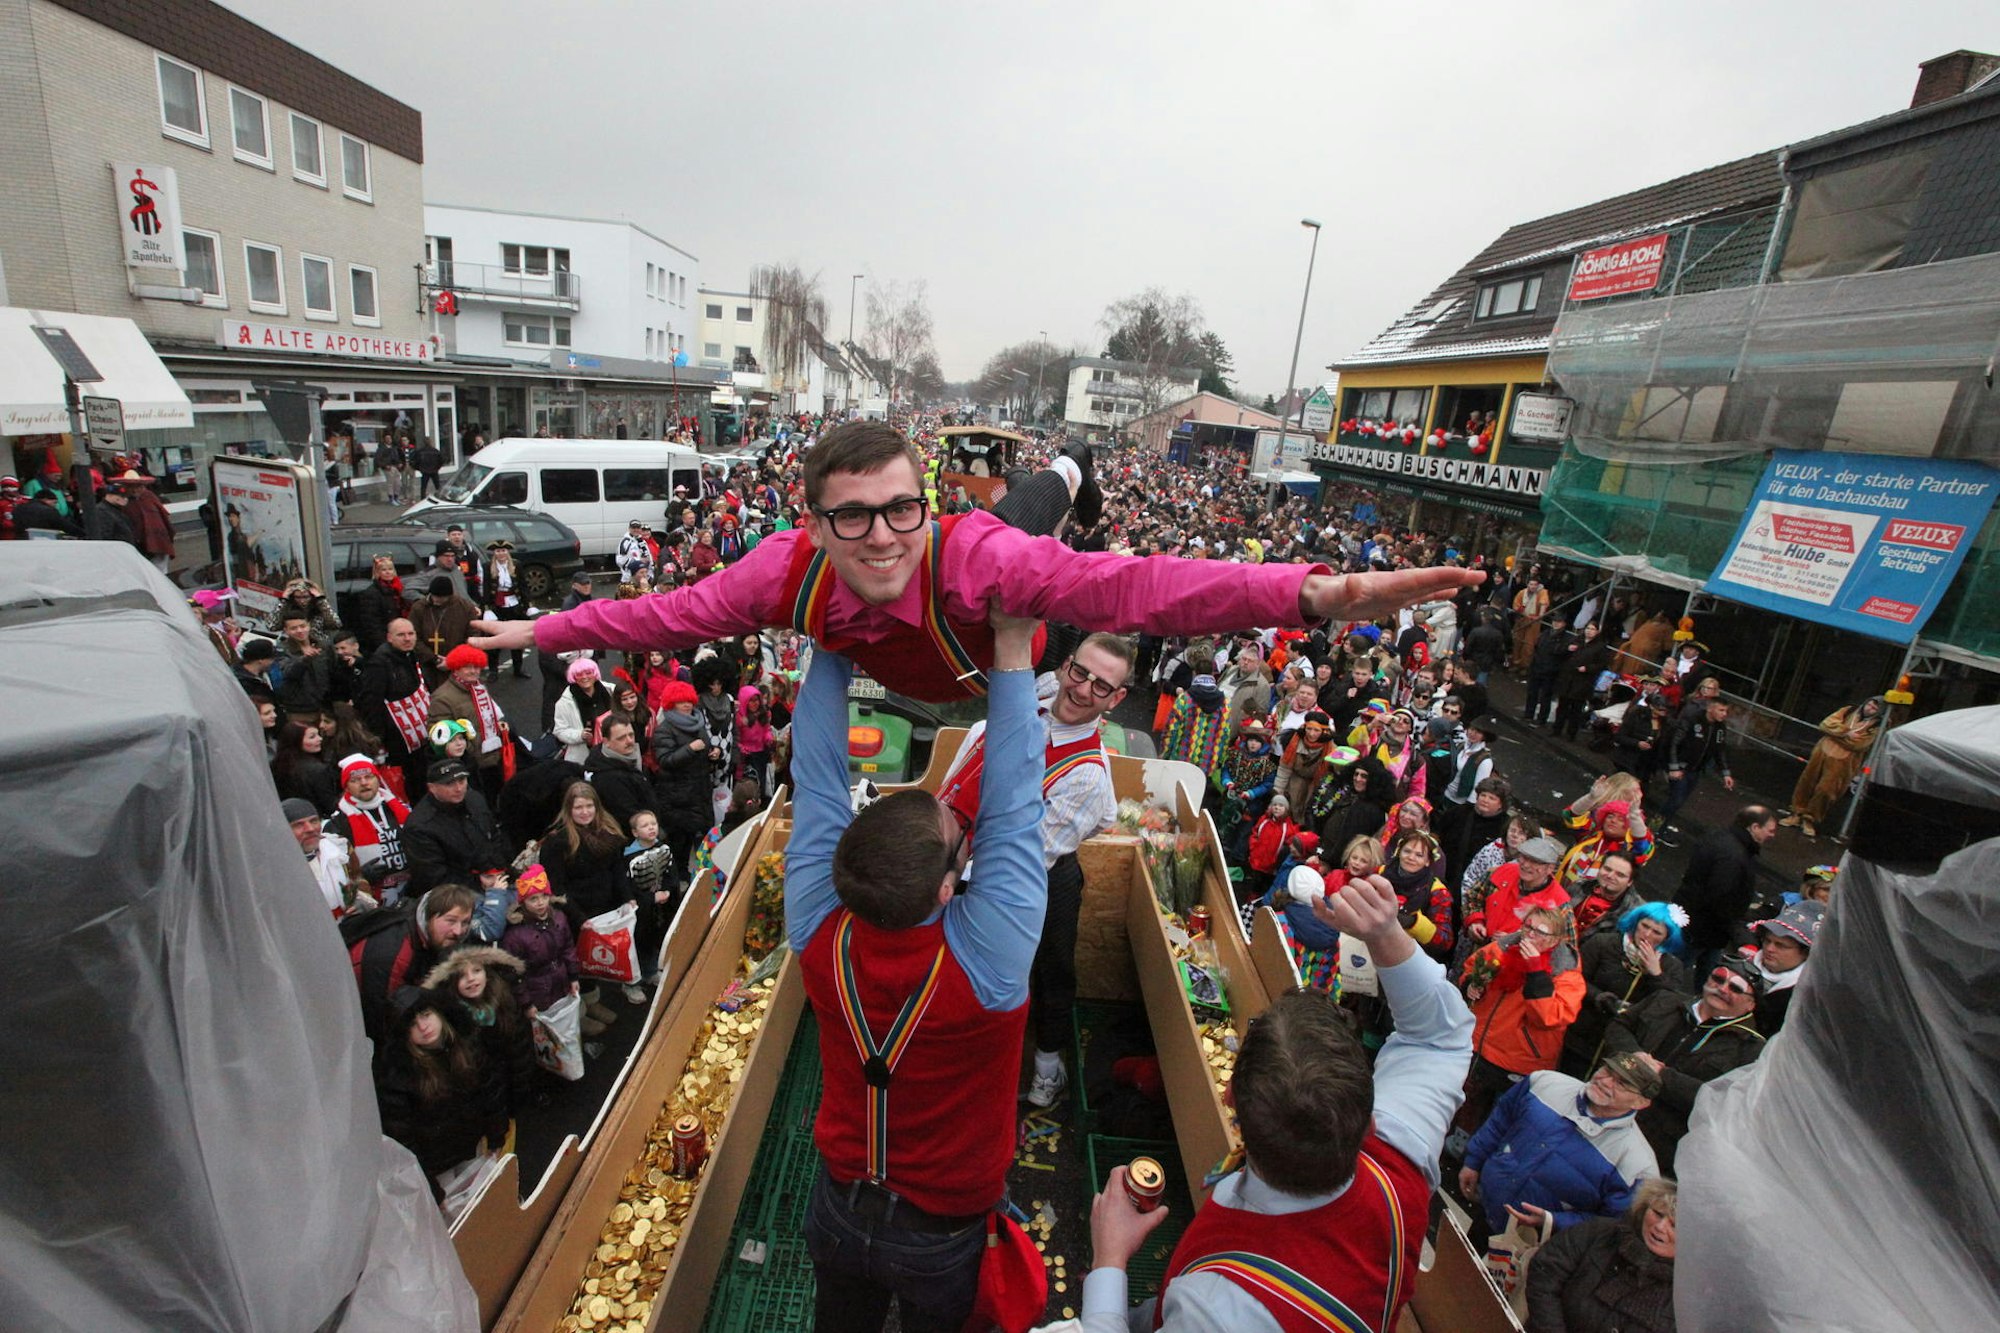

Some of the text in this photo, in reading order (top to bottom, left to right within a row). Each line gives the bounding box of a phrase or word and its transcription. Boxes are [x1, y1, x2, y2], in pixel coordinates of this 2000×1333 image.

[142, 240, 160, 251] Alte
[132, 250, 173, 264] Apotheke
[1576, 254, 1620, 275] RÖHRIG
[1619, 251, 1629, 267] &
[1630, 244, 1662, 265] POHL
[263, 328, 314, 349] ALTE
[325, 335, 412, 357] APOTHEKE
[1313, 444, 1541, 493] SCHUHHAUS BUSCHMANN
[1775, 463, 1823, 481] VELUX
[1835, 469, 1861, 485] der
[1863, 474, 1914, 491] starke
[1918, 476, 1989, 496] Partner
[1767, 480, 1909, 510] für den Dachausbau
[1783, 518, 1843, 533] Fachbetrieb für
[1792, 535, 1850, 551] Abdichtungen
[1808, 529, 1850, 543] Fassaden
[1784, 543, 1826, 563] Hube
[1826, 558, 1850, 569] GmbH
[1878, 546, 1945, 564] Geschulter
[1880, 557, 1927, 574] Betrieb
[848, 688, 884, 699] GH 6330
